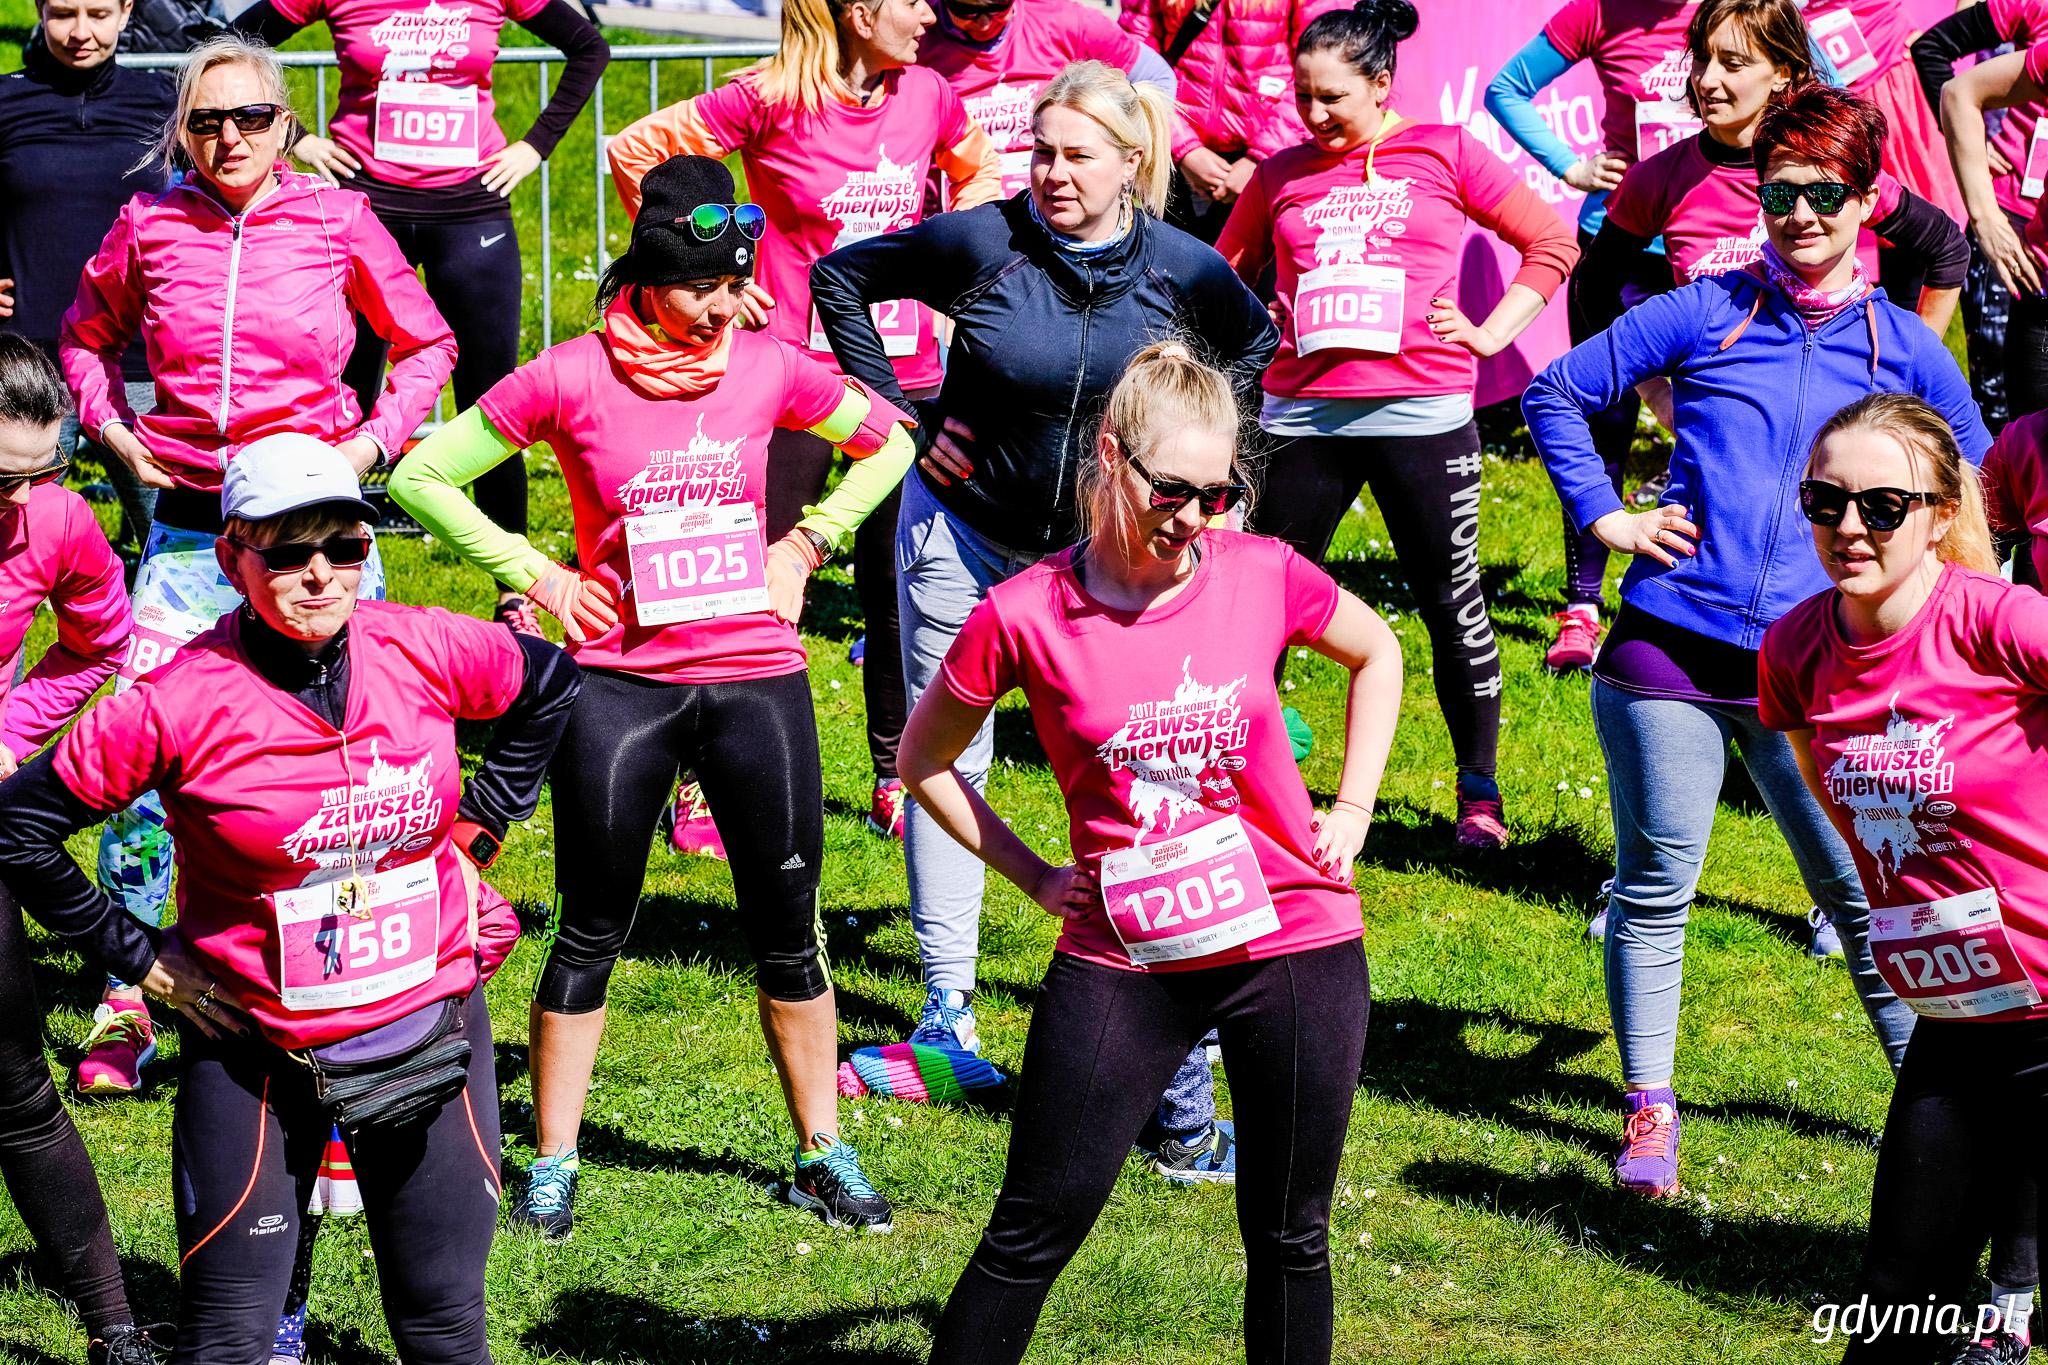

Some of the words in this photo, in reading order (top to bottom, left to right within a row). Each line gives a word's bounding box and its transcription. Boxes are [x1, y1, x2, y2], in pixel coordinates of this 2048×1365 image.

[389, 110, 466, 142] 1097
[852, 221, 881, 233] GDYNIA
[1716, 236, 1735, 250] 2017
[1308, 292, 1383, 326] 1105
[650, 450, 672, 464] 2017
[675, 454, 694, 463] BIEG
[696, 452, 725, 462] KOBIET
[648, 542, 749, 591] 1025
[1129, 702, 1154, 720] 2017
[1159, 705, 1182, 717] BIEG
[1184, 700, 1216, 713] KOBIET
[1846, 735, 1869, 750] 2017
[1872, 742, 1892, 751] BIEG
[1893, 739, 1921, 750] KOBIET
[1149, 766, 1192, 782] GDYNIA
[321, 787, 347, 807] 2017
[354, 791, 375, 803] BIEG
[378, 782, 411, 799] KOBIET
[1864, 806, 1905, 821] GDYNIA
[1215, 832, 1238, 846] GDYNIA
[1151, 846, 1189, 865] pier(w)si!
[1154, 842, 1183, 856] zawsze
[780, 861, 806, 870] adidas
[1154, 861, 1168, 869] 2017
[406, 877, 430, 889] GDYNIA
[1123, 862, 1246, 932] 1205
[1968, 907, 1992, 918] GDYNIA
[313, 912, 412, 975] 758
[1887, 938, 2001, 990] 1206
[249, 1221, 289, 1236] Kalenji
